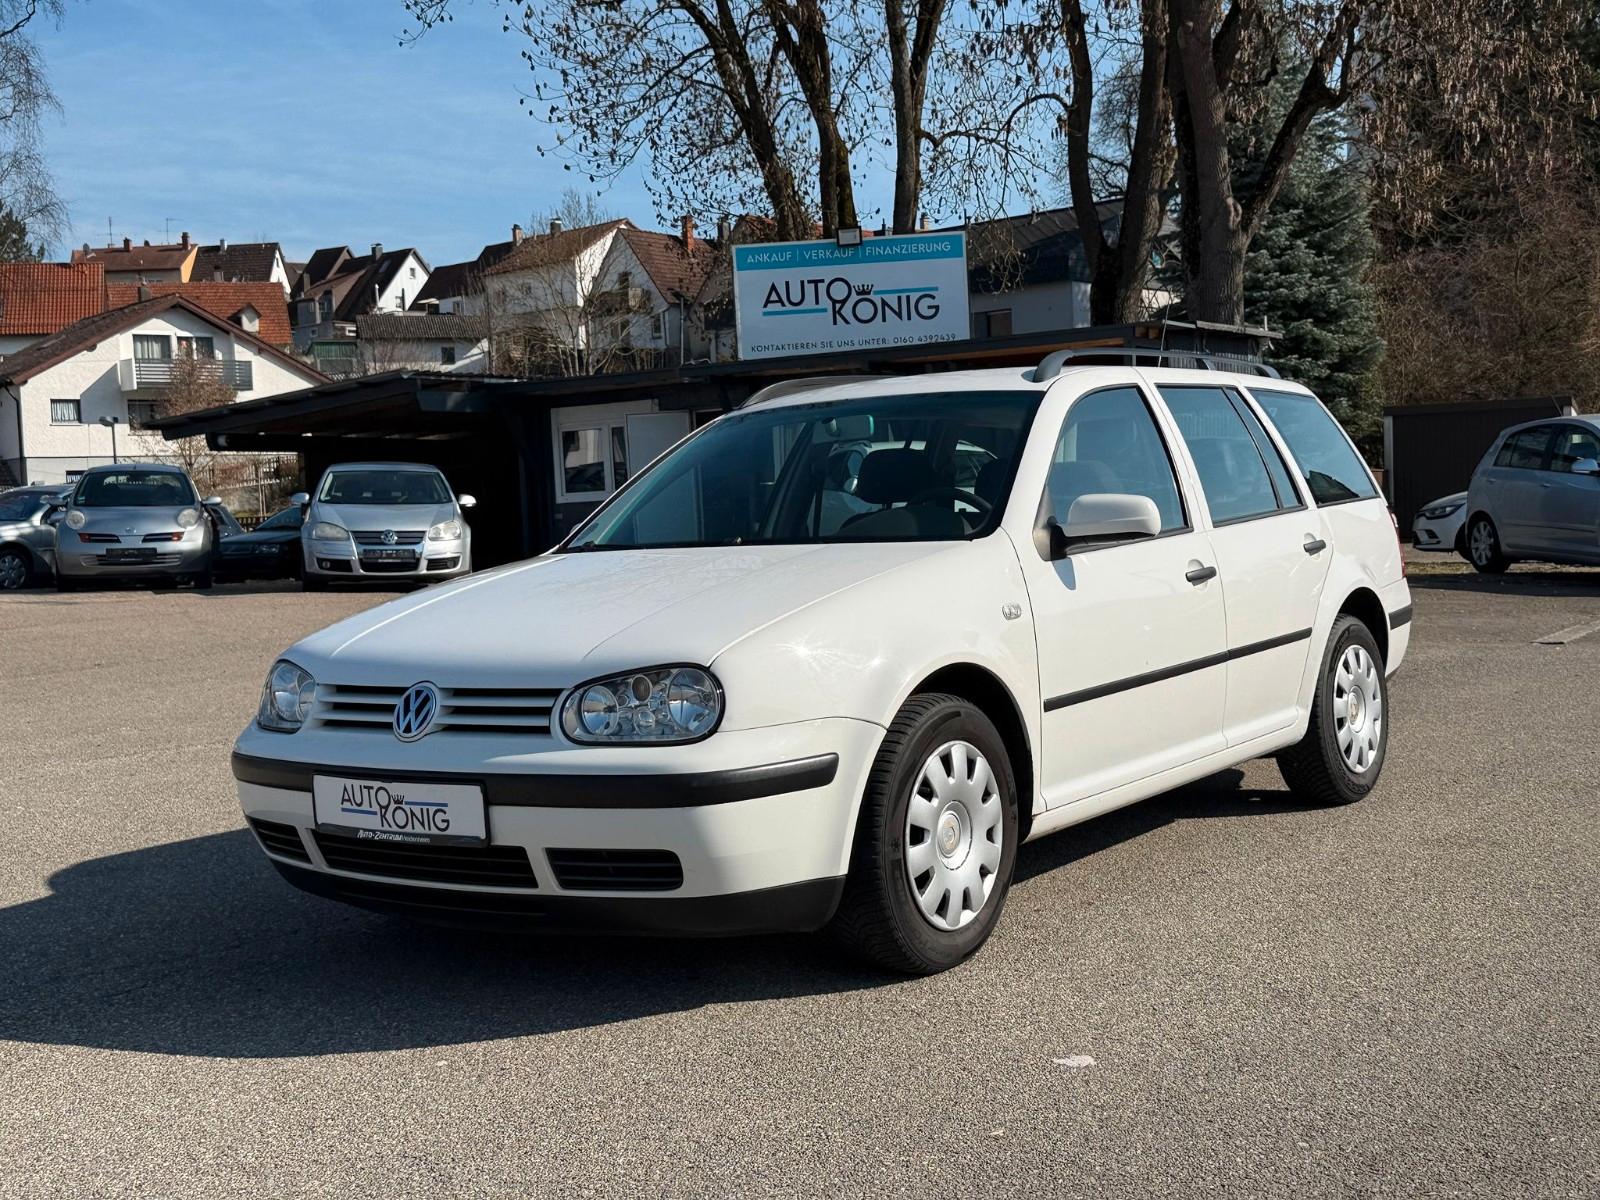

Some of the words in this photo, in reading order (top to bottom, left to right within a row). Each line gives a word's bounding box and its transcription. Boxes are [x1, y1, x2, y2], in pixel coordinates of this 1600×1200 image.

[747, 251, 792, 263] ANKAUF
[803, 247, 855, 260] VERKAUF
[865, 241, 951, 256] FINANZIERUNG
[762, 277, 853, 309] AUTO
[751, 342, 817, 353] KONTAKTIEREN
[820, 340, 834, 349] SIE
[836, 338, 855, 348] UNS
[858, 337, 890, 347] UNTER:
[893, 336, 914, 345] 0160
[341, 783, 392, 810] AUTO
